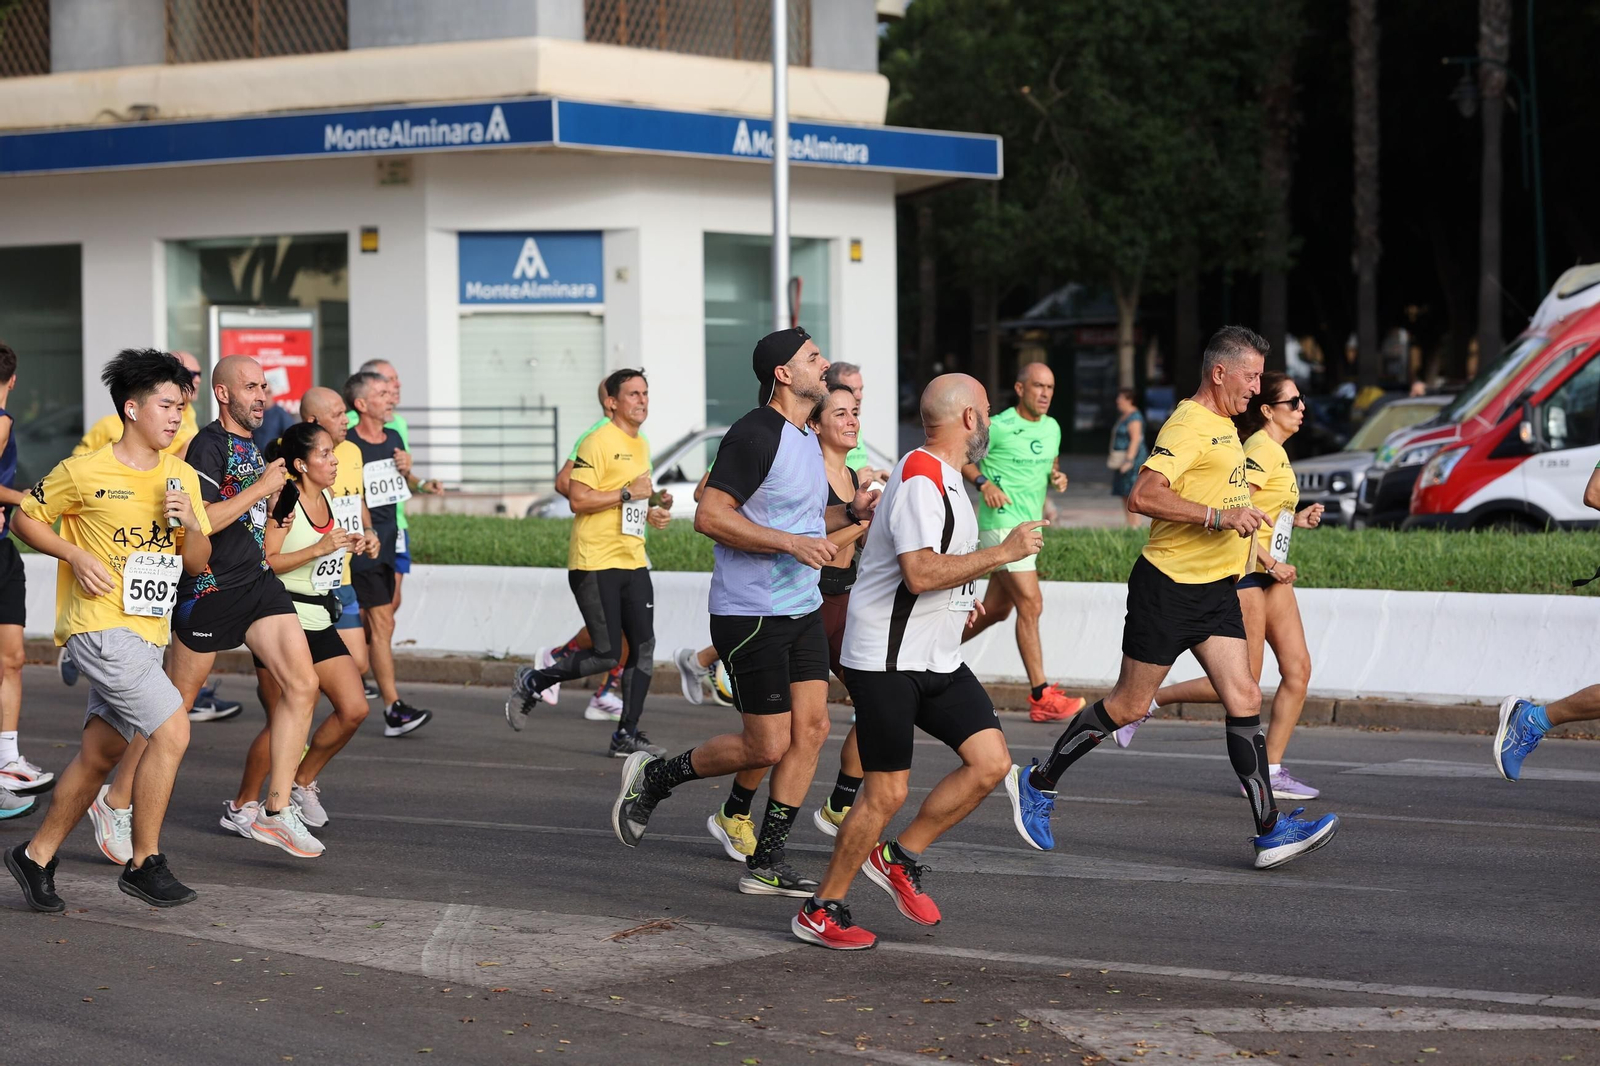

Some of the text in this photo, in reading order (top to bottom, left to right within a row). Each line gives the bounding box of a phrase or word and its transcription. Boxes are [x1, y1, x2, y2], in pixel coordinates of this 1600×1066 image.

[324, 118, 484, 150] MonteAlminara
[752, 129, 869, 164] MoteAlminara
[465, 280, 597, 299] MonteAlminara
[369, 476, 404, 495] 6019
[113, 527, 144, 548] 45
[135, 555, 155, 565] 45
[129, 578, 177, 602] 5697
